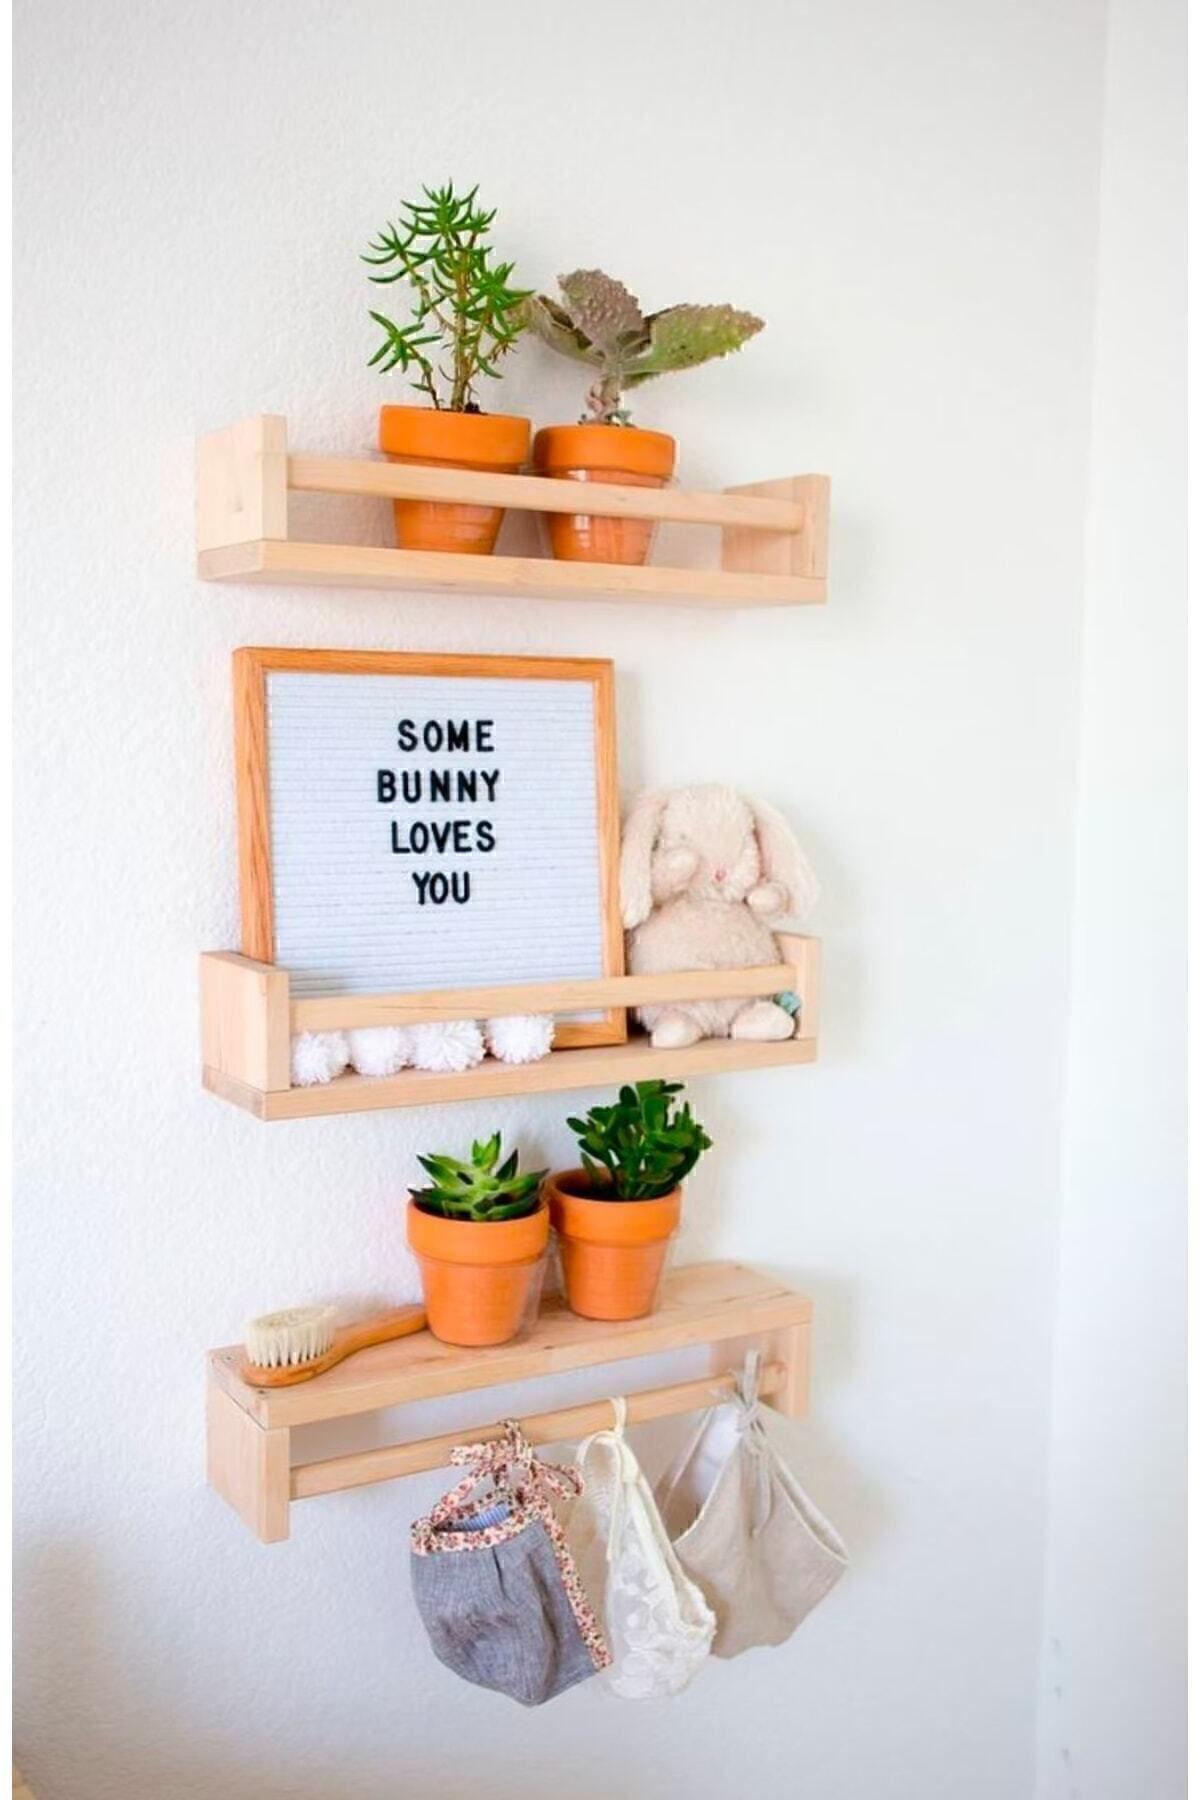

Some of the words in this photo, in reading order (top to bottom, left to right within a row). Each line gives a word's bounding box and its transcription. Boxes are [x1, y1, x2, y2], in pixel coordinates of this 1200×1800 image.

[397, 719, 495, 753] SOME
[377, 769, 501, 804] BUNNY
[391, 820, 496, 854] LOVES
[412, 871, 471, 906] YOU
